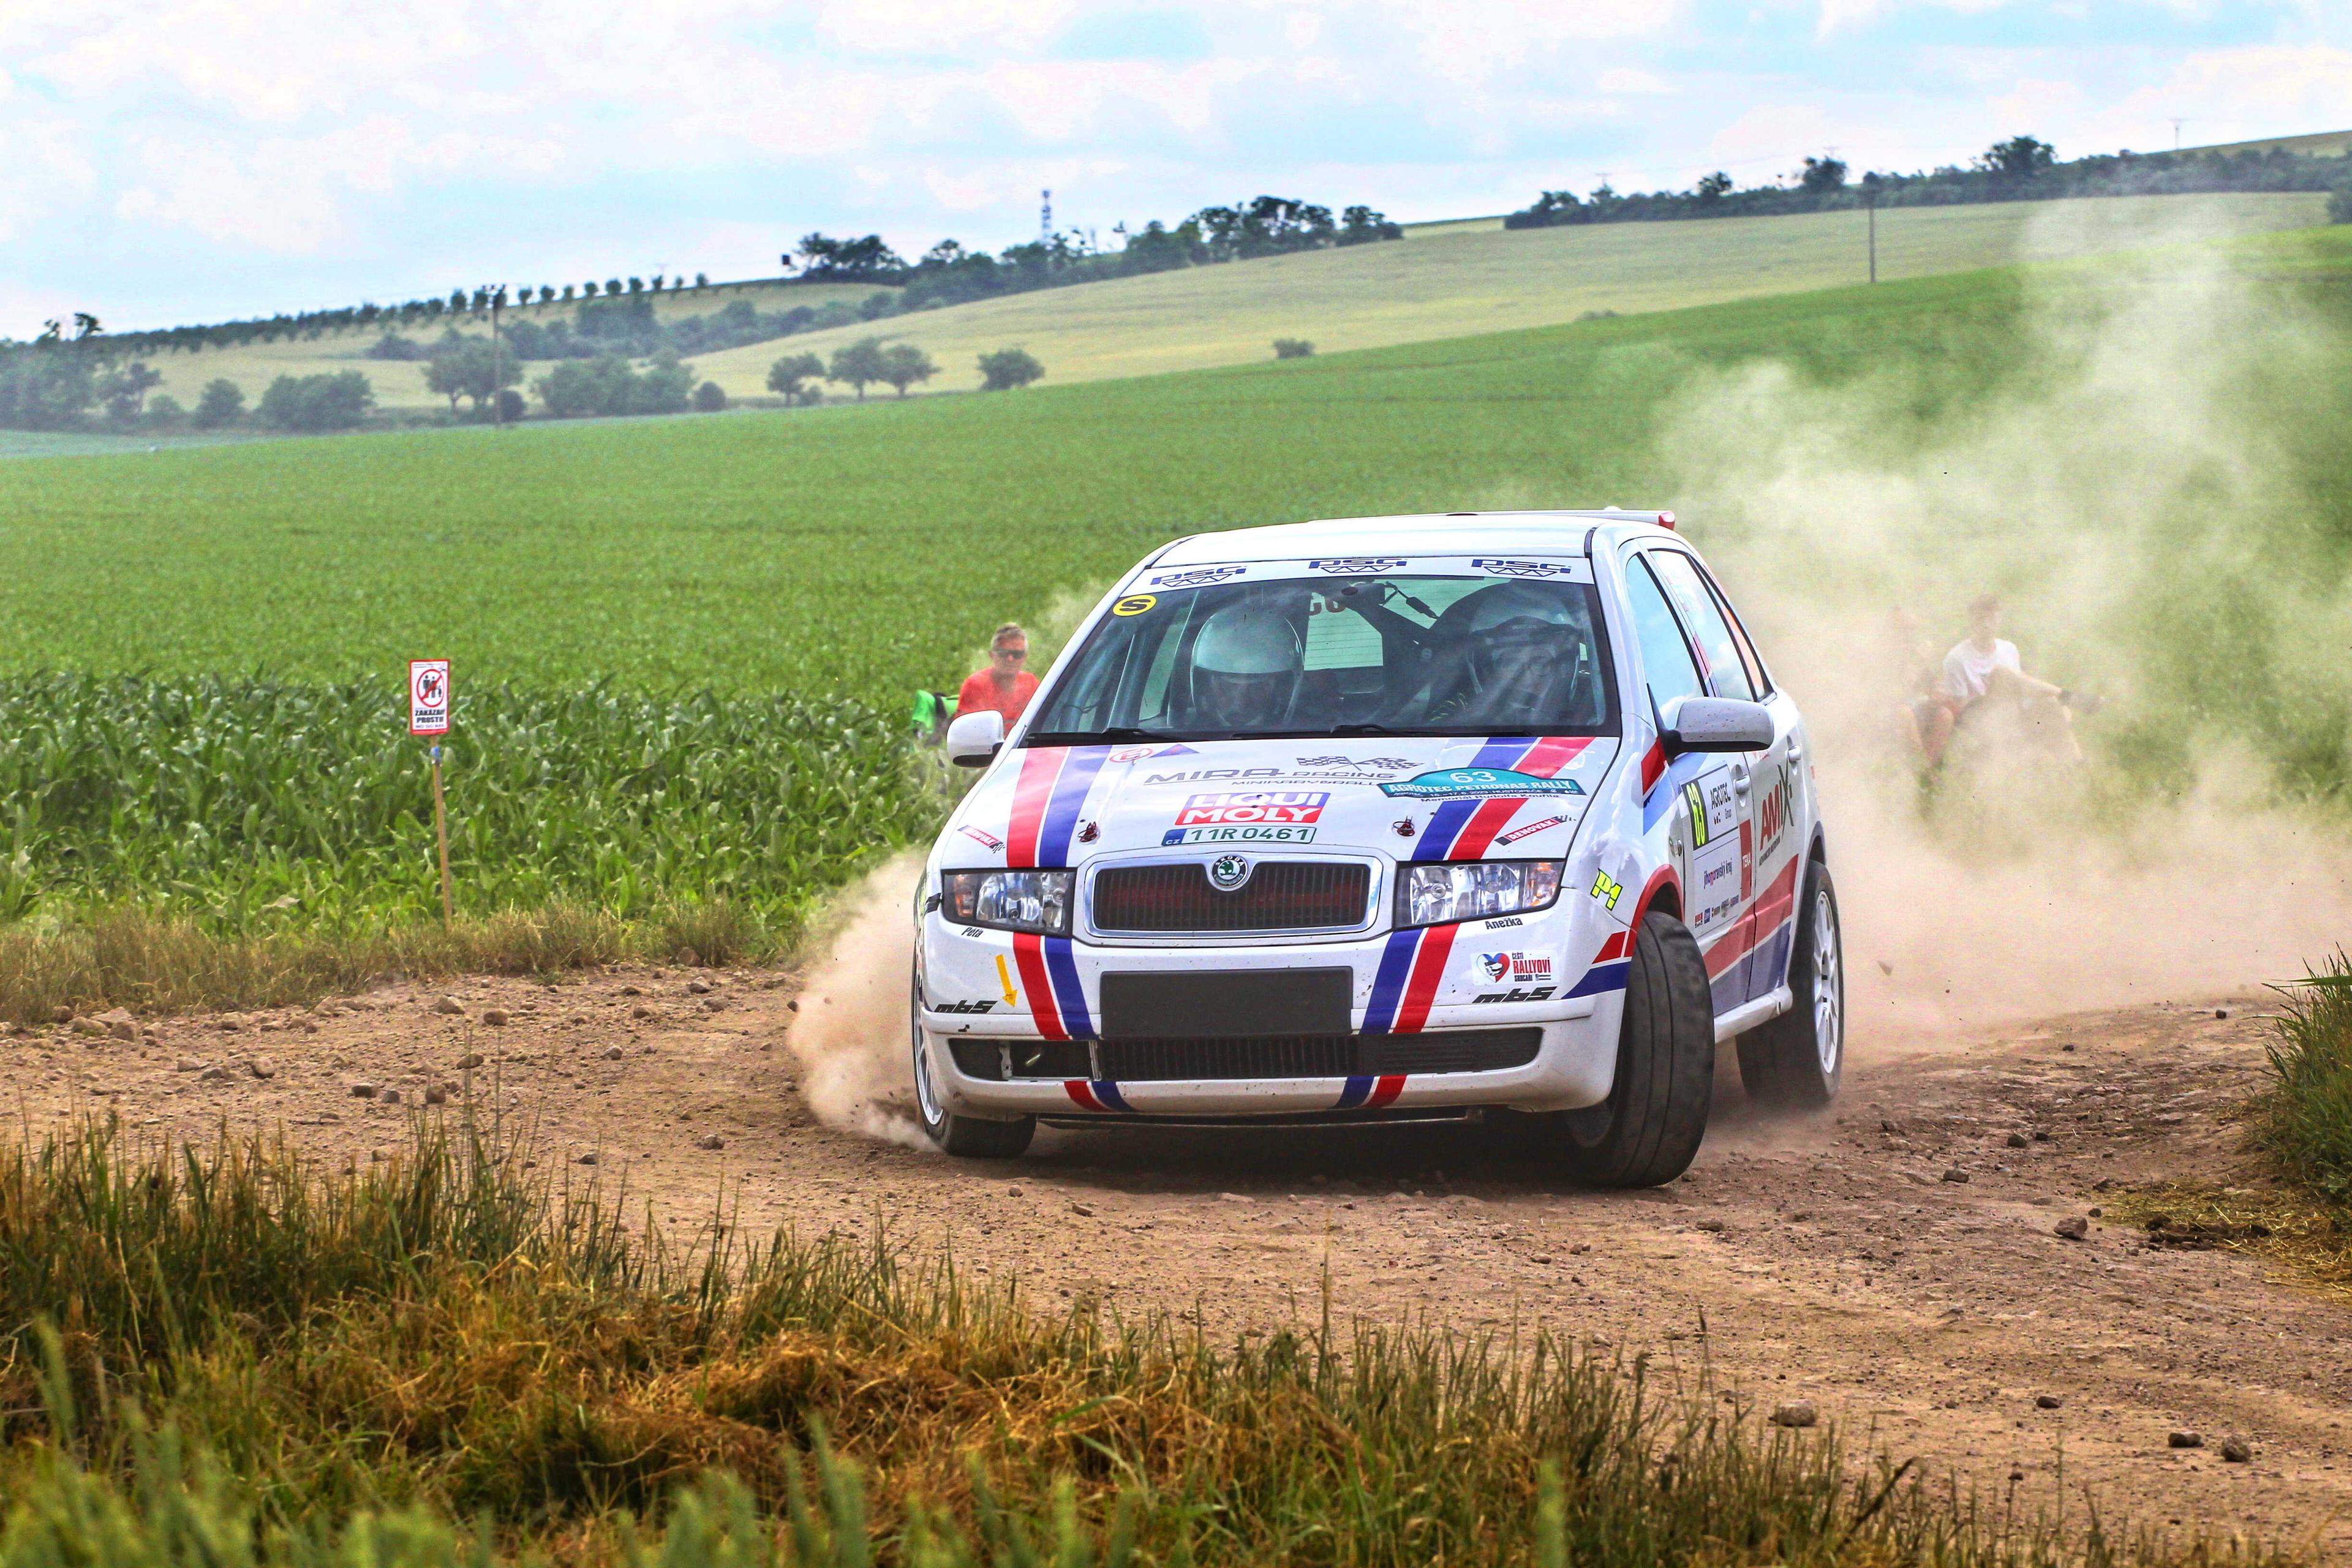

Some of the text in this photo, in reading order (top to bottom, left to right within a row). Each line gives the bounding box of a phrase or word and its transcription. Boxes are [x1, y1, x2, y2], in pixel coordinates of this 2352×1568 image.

[1119, 598, 1151, 612] S
[1450, 771, 1497, 783] 63
[1389, 784, 1452, 793] AGROTEC
[1532, 780, 1572, 789] RALLY
[1191, 793, 1323, 807] LIQUI
[1710, 782, 1731, 810] AGROTEC
[1182, 807, 1321, 823] MOLY
[1686, 782, 1705, 846] 63
[1485, 917, 1523, 930] Anežka
[1513, 957, 1551, 974] RALLYOVÍ
